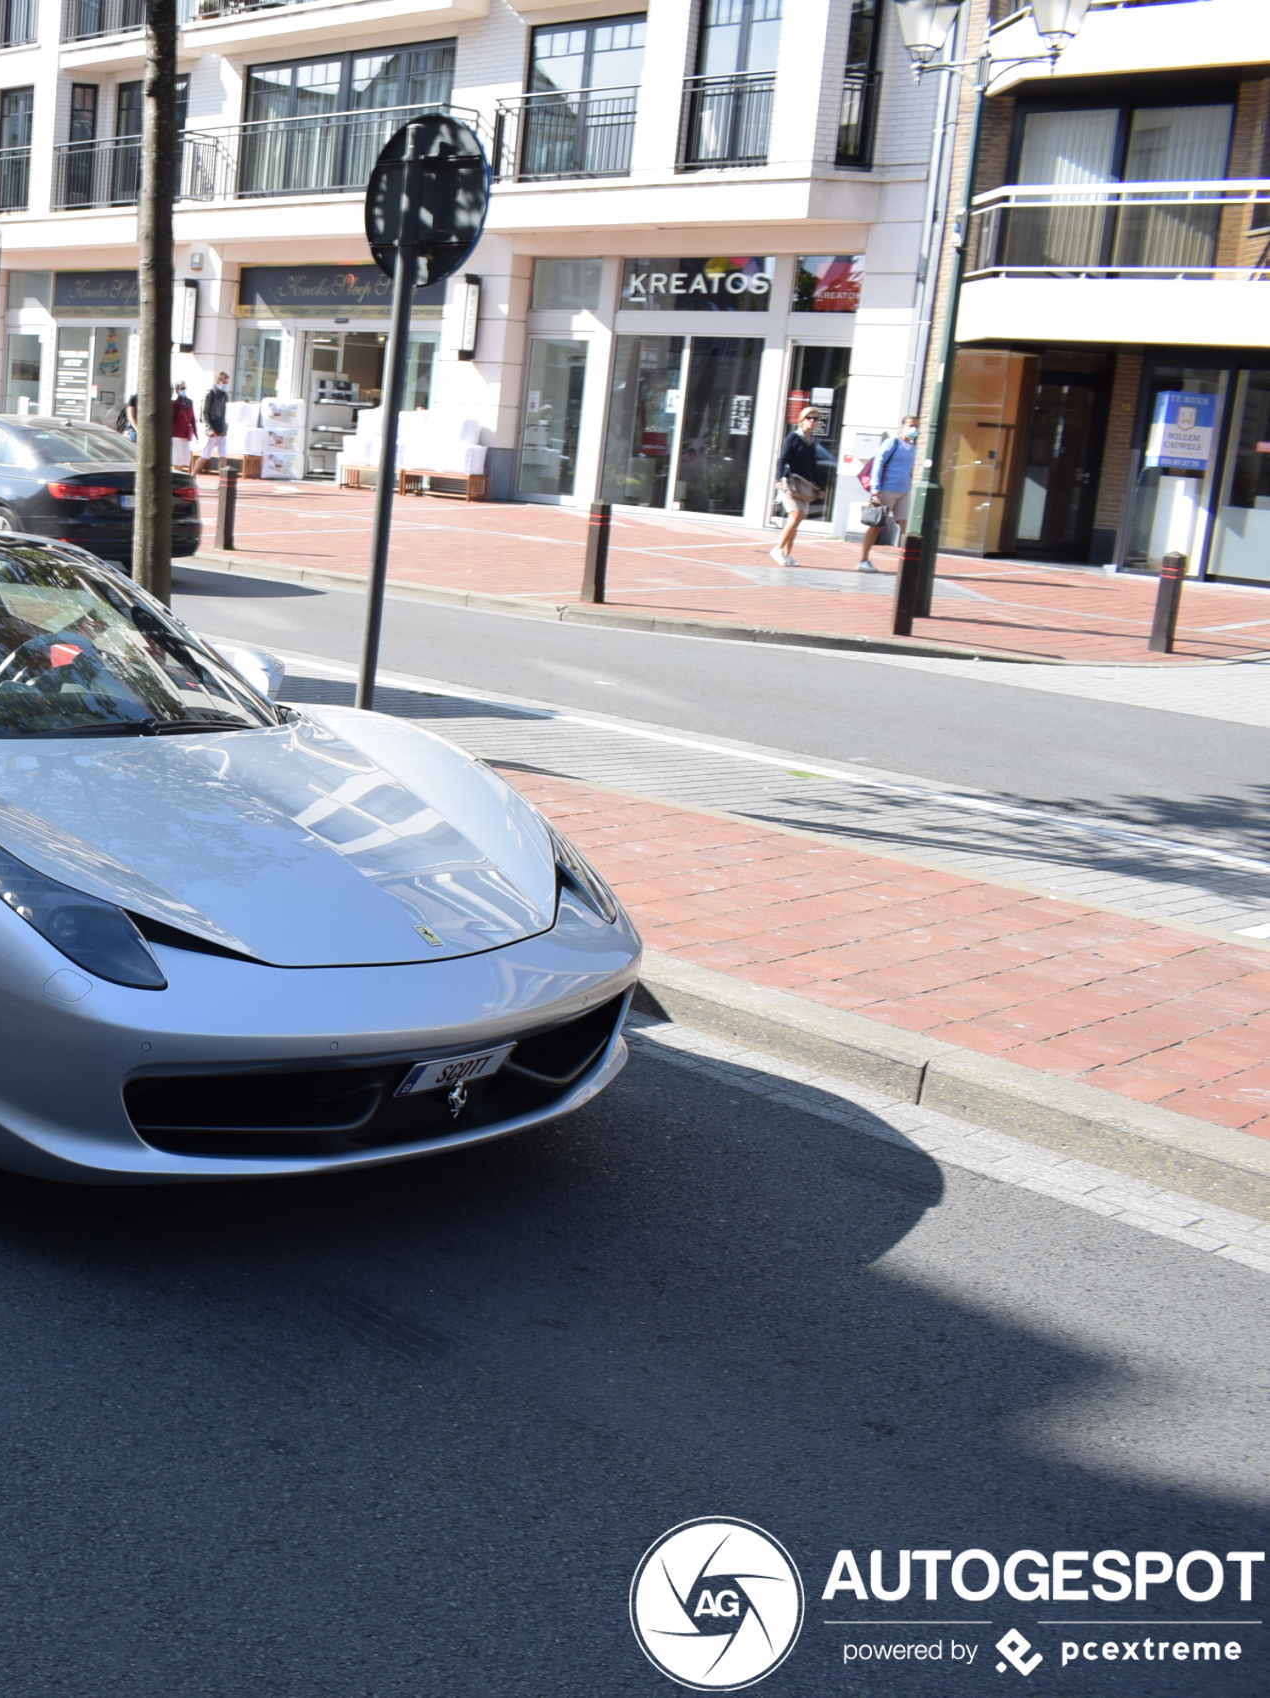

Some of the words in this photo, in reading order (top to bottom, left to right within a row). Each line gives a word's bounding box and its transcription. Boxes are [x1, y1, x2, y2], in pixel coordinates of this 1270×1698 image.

[332, 274, 371, 304] Sleep
[630, 272, 769, 295] KREATOS
[1170, 394, 1182, 403] TE
[1184, 396, 1210, 405] HUUR
[1168, 432, 1201, 442] WILLEM
[1164, 442, 1202, 450] CAUWELS
[435, 1055, 494, 1084] SCOTT
